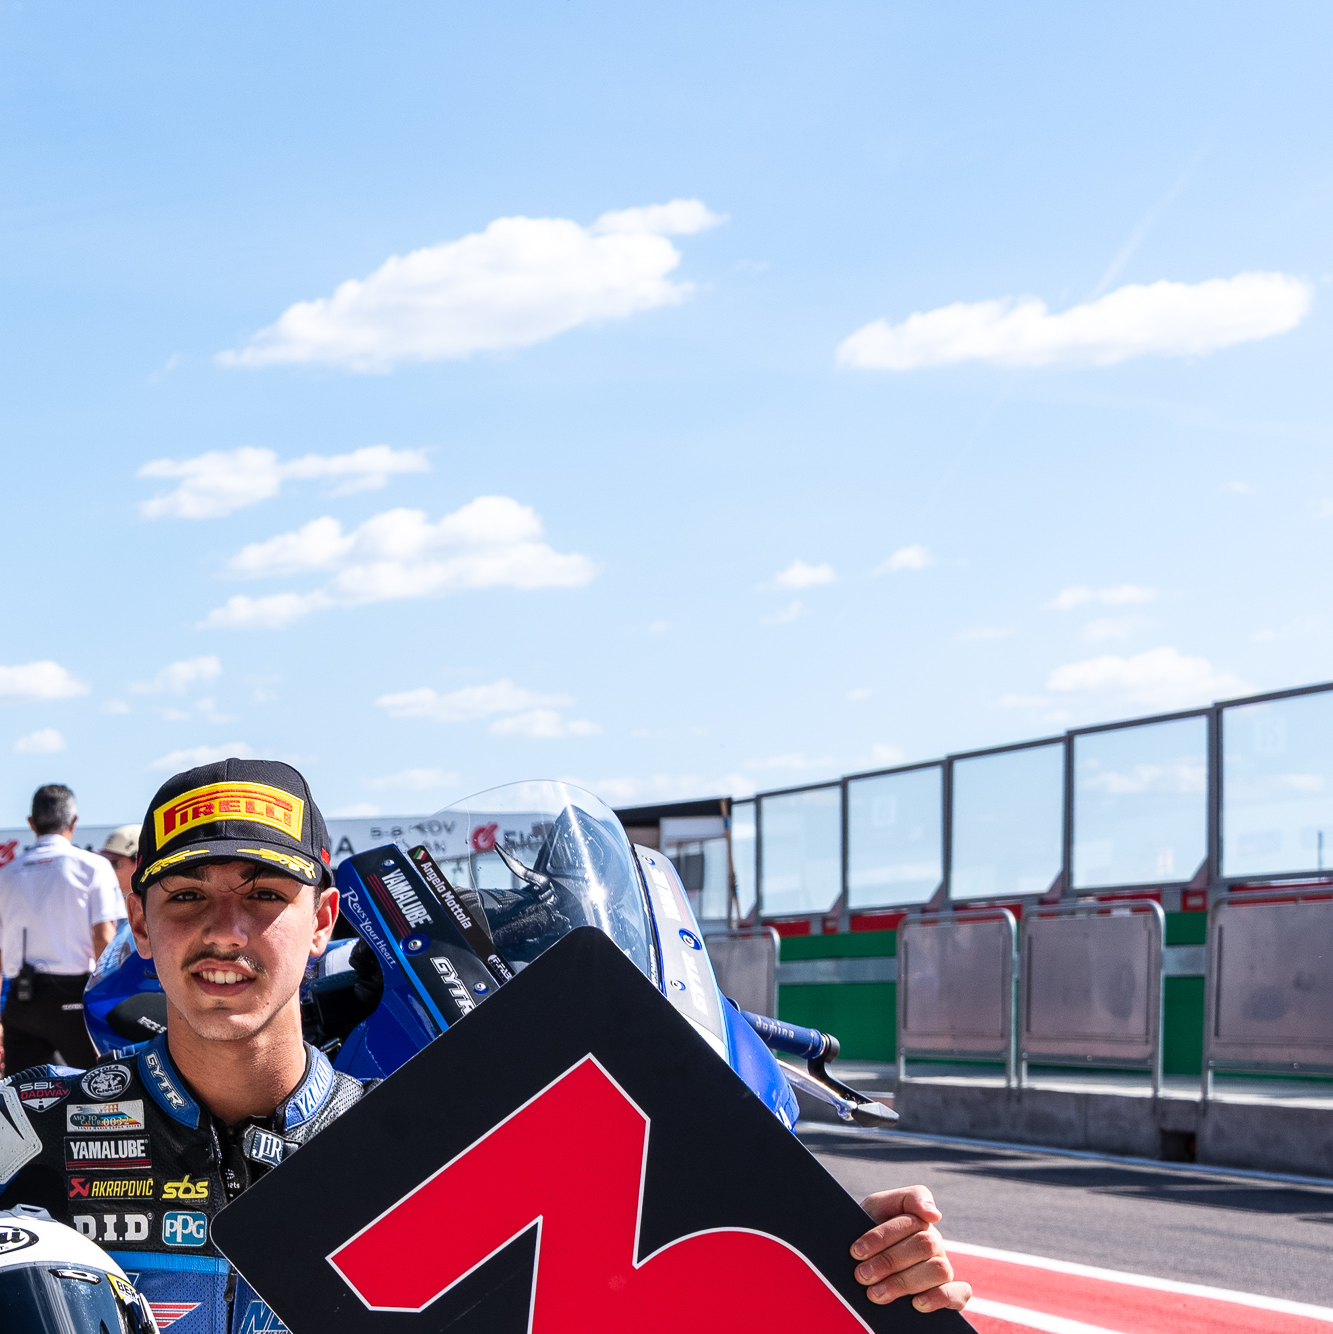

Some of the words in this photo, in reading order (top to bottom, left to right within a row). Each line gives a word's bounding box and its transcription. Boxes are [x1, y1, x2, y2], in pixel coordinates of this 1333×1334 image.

[163, 788, 293, 838] PIRELLI
[382, 868, 432, 929] YAMALUBE
[421, 861, 445, 896] Angelo
[440, 888, 472, 930] Mottola
[341, 886, 369, 924] Revs
[359, 917, 380, 946] Your
[376, 938, 397, 970] Heart
[20, 1088, 70, 1101] OADWAY
[145, 1052, 187, 1110] GYTR
[296, 1057, 334, 1120] YAMAHA
[103, 1117, 130, 1126] 0032
[70, 1139, 146, 1160] YAMALUBE
[91, 1178, 154, 1197] AKRAPOVIČ
[162, 1174, 209, 1199] sbs
[74, 1214, 149, 1241] D.I.D
[165, 1215, 204, 1242] PPG
